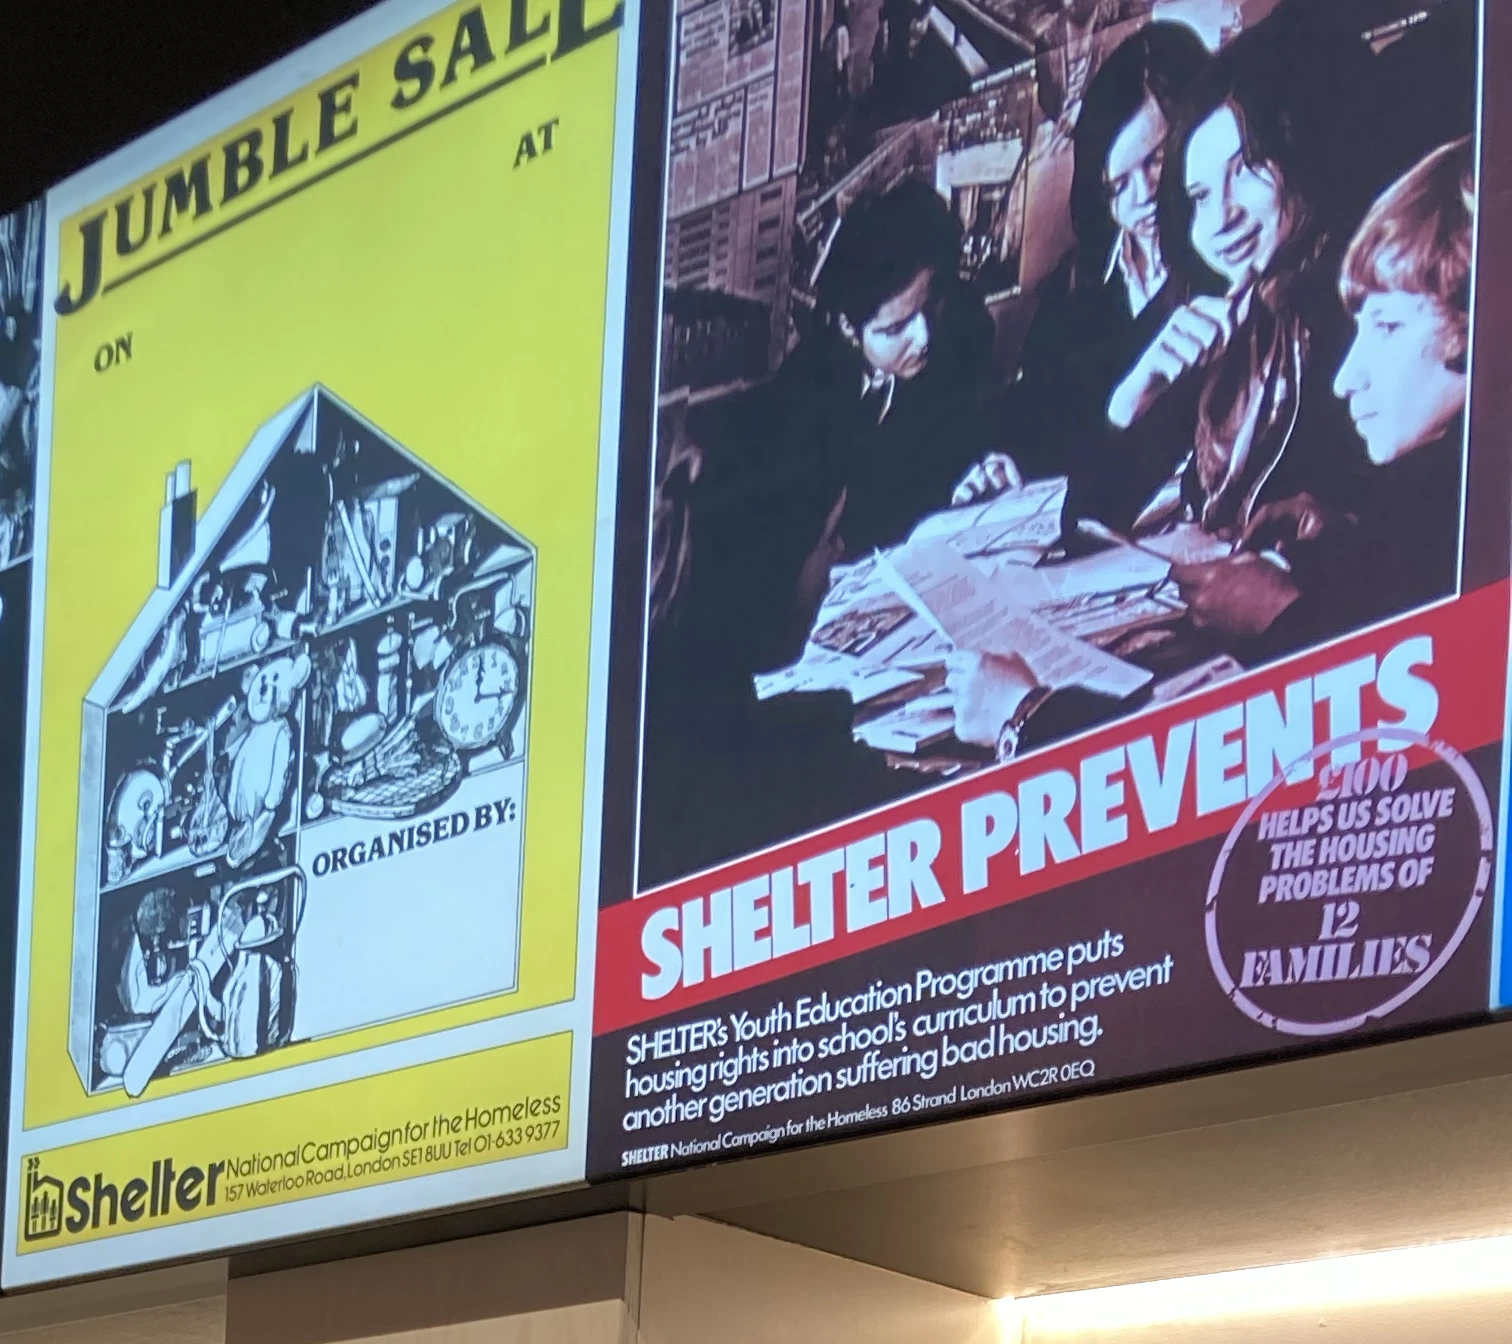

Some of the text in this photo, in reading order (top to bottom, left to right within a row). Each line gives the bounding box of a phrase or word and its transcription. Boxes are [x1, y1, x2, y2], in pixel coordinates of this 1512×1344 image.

[513, 119, 560, 170] AT
[53, 70, 361, 316] JUMBLE
[93, 332, 134, 374] ON
[1258, 788, 1456, 841] HELPS US SOLVE
[1316, 753, 1408, 801] £100
[312, 797, 516, 877] ORGANISED BY:
[641, 635, 1439, 1001] SHELTER PREVENTS
[1270, 823, 1436, 871] THE HOUSING
[1258, 856, 1435, 904] PROBLEMS OF
[1317, 901, 1360, 941] 12
[626, 930, 1123, 1066] SHELTER's Youth Education Programme puts
[1240, 933, 1433, 988] FAMILIES
[624, 957, 1172, 1097] housing rights into school's curriculum to prevent
[622, 1014, 1103, 1130] another generation suffering bad housing.
[226, 1099, 560, 1179] National Campaign for the Homeless
[621, 1143, 667, 1166] SHELTER
[670, 1133, 720, 1157] National
[722, 1123, 784, 1146] Campaign
[786, 1119, 804, 1134] for
[806, 1114, 825, 1130] the
[828, 1105, 887, 1126] Homeless
[891, 1096, 910, 1114] 86
[913, 1087, 956, 1109] Strand
[960, 1080, 1010, 1100] London
[1012, 1068, 1058, 1090] WC2R
[66, 1158, 225, 1235] Shelter
[224, 1184, 242, 1203] 157
[245, 1174, 302, 1199] Waterloo
[304, 1164, 345, 1187] Road,
[346, 1156, 398, 1178] London
[401, 1148, 422, 1168] SE1
[424, 1142, 450, 1163] 8UU
[453, 1138, 469, 1157] Tel
[524, 1121, 559, 1143] 9377
